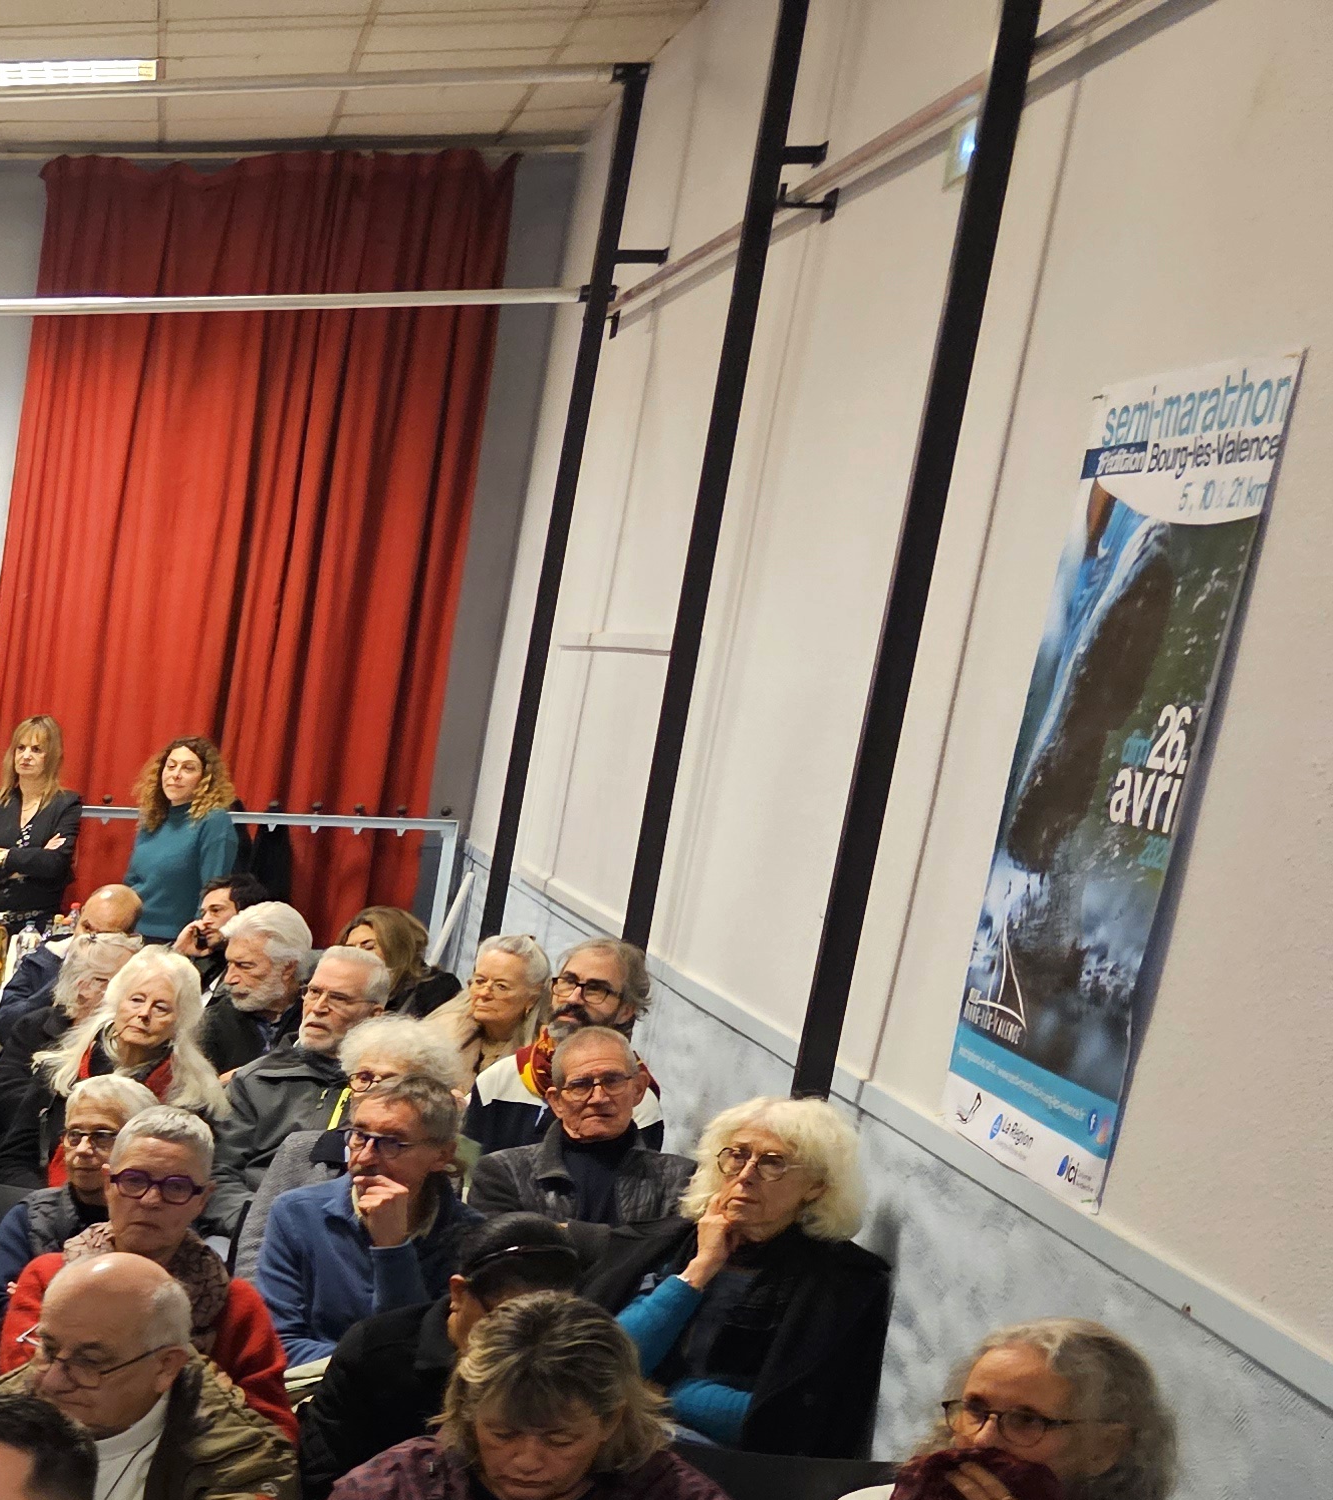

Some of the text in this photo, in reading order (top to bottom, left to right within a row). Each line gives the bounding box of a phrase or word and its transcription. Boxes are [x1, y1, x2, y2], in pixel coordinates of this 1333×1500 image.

[1101, 367, 1292, 448] semi-marathon
[1146, 430, 1282, 479] Bourg-lès-Valence
[1146, 704, 1192, 774] 26
[1109, 759, 1187, 834] avri
[1010, 1121, 1034, 1150] Région
